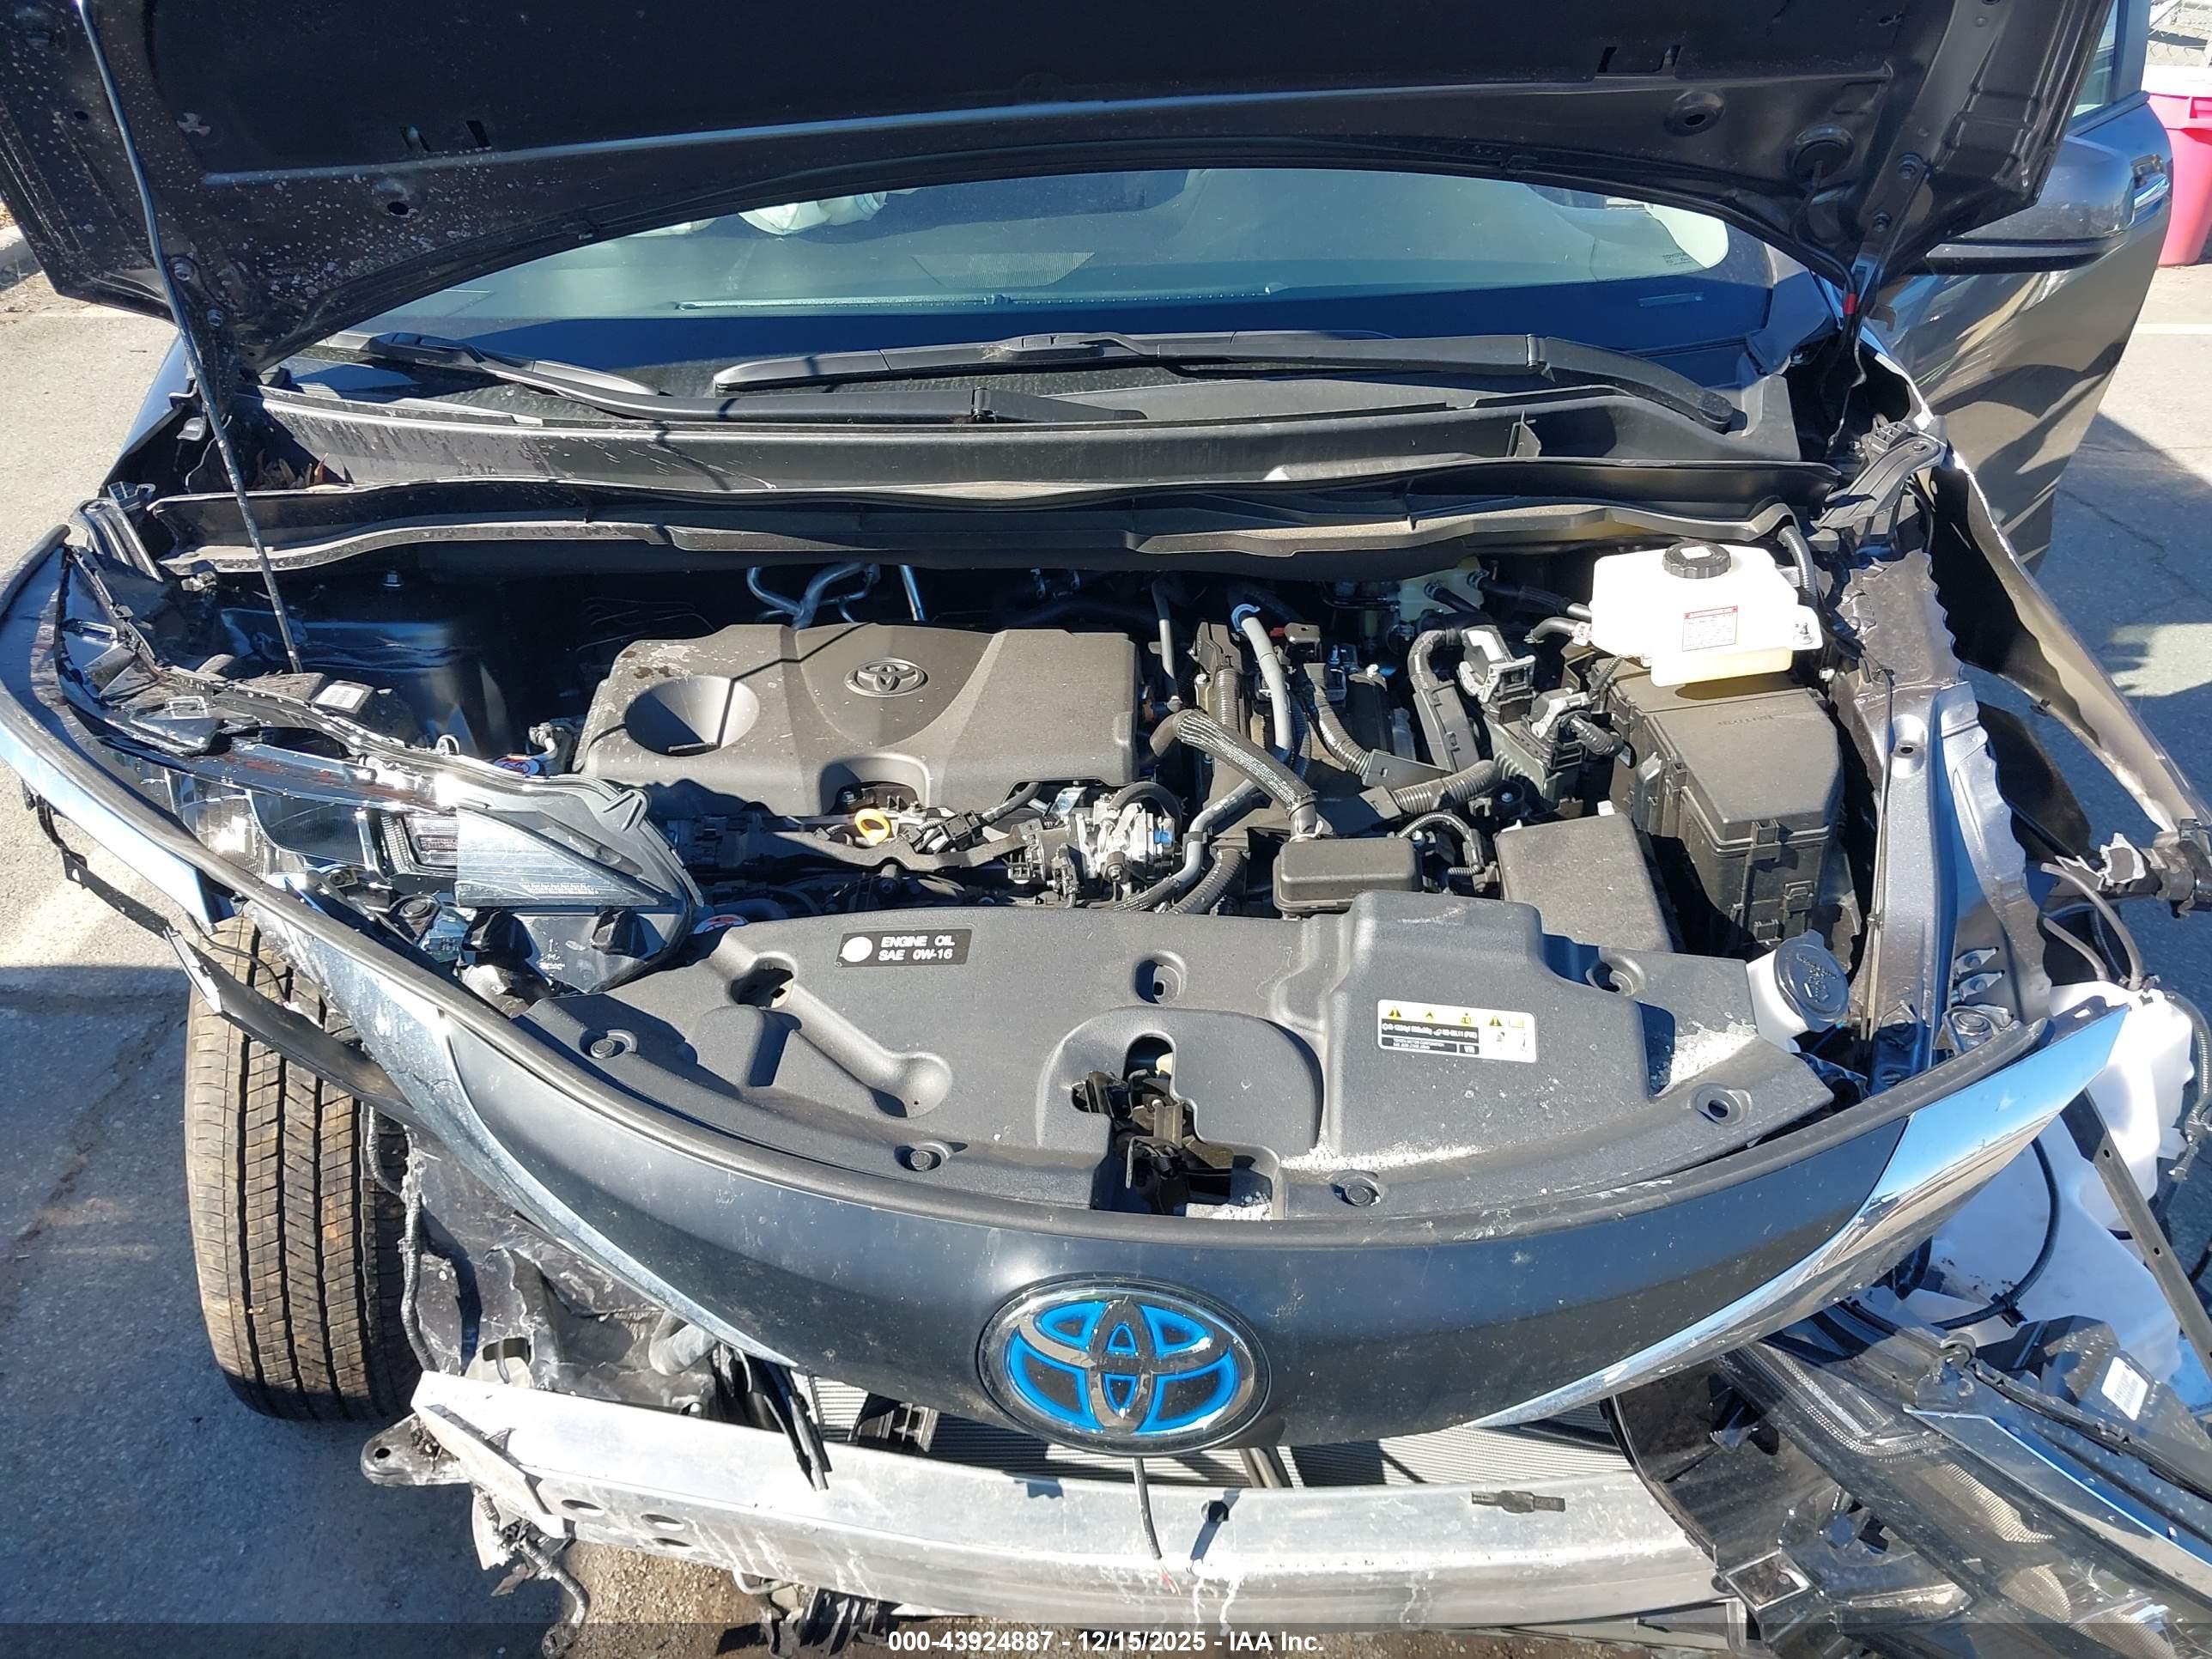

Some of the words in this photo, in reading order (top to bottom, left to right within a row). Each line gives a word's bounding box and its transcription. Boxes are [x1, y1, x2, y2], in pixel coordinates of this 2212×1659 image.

[881, 935, 927, 948] ENGINE
[934, 935, 955, 946] OIL
[878, 949, 906, 961] SAE
[912, 948, 953, 960] 0W-16
